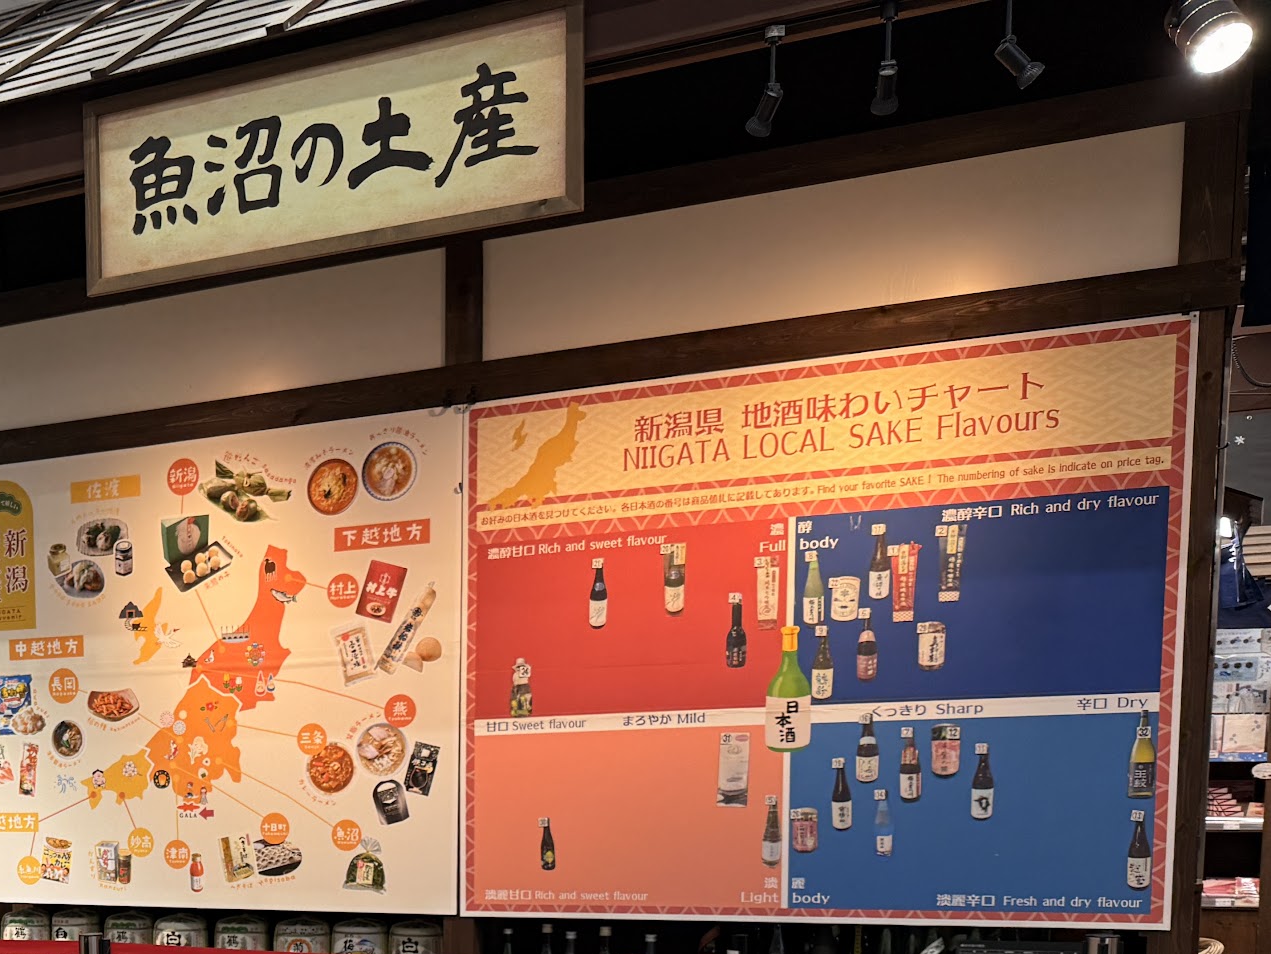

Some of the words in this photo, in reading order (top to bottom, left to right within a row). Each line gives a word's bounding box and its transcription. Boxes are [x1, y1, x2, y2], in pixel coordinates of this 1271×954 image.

[129, 62, 539, 236] 魚沼の土産
[635, 408, 724, 443] 新潟県
[742, 374, 1045, 431] 地酒味わいチャート
[623, 438, 730, 472] NIIGATA
[743, 427, 834, 459] LOCAL
[849, 418, 923, 449] SAKE
[936, 409, 1060, 441] Flavours
[169, 467, 197, 483] 新潟
[817, 484, 836, 495] Find
[838, 482, 858, 494] your
[862, 478, 896, 491] favorite
[899, 476, 924, 488] SAKE
[937, 473, 955, 483] The
[957, 468, 1005, 483] numbering
[1009, 466, 1020, 477] of
[1023, 464, 1044, 476] sake
[1047, 463, 1056, 473] is
[1059, 460, 1097, 473] indicate
[1101, 460, 1113, 469] on
[1117, 456, 1141, 469] price
[1145, 455, 1164, 467] tag.
[87, 479, 120, 499] 佐渡
[1011, 503, 1038, 516] Rich
[1045, 500, 1071, 513] and
[1077, 498, 1101, 512] dry
[1107, 493, 1159, 508] flavour
[342, 524, 423, 547] 下越地方
[539, 542, 560, 554] Rich
[565, 540, 585, 552] and
[590, 537, 622, 550] sweet
[627, 533, 668, 547] flavour
[759, 540, 786, 553] Full
[799, 536, 839, 550] body
[5, 529, 28, 593] 新潟
[329, 581, 356, 595] 村上
[15, 640, 78, 657] 中越地方
[51, 676, 76, 691] 長岡
[872, 704, 927, 717] くっきり
[935, 702, 984, 716] Sharp
[1077, 698, 1107, 710] 辛口
[1117, 696, 1149, 709] Dry
[486, 721, 509, 732] 甘口
[512, 719, 544, 731] Sweet
[549, 717, 586, 730] flavour
[623, 714, 672, 727] まろやか
[677, 712, 705, 724] Mild
[775, 701, 799, 743] 日本酒
[300, 731, 323, 745] 三条
[334, 826, 359, 841] 魚沼
[535, 890, 555, 900] Rich
[559, 890, 576, 900] and
[581, 890, 609, 901] sweet
[613, 890, 648, 901] flavour
[741, 891, 778, 905] Light
[792, 892, 830, 905] body
[1003, 895, 1037, 907] Fresh
[1042, 896, 1065, 907] and
[1070, 896, 1092, 909] dry
[1097, 896, 1143, 908] flavour
[55, 927, 68, 939] 白
